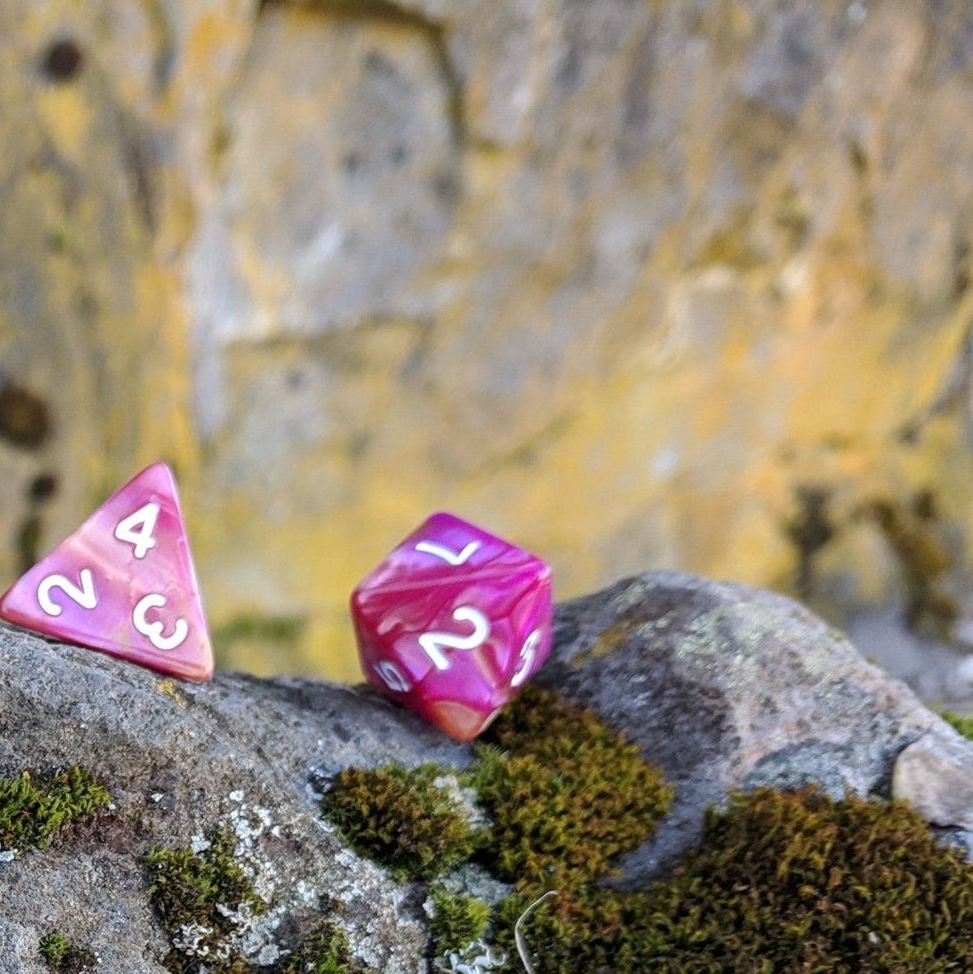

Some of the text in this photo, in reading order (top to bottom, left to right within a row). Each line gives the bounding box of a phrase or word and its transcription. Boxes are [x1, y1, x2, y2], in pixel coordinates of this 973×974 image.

[114, 502, 160, 558] 4
[37, 568, 97, 616] 2
[133, 593, 188, 649] 3
[419, 606, 490, 670] 2
